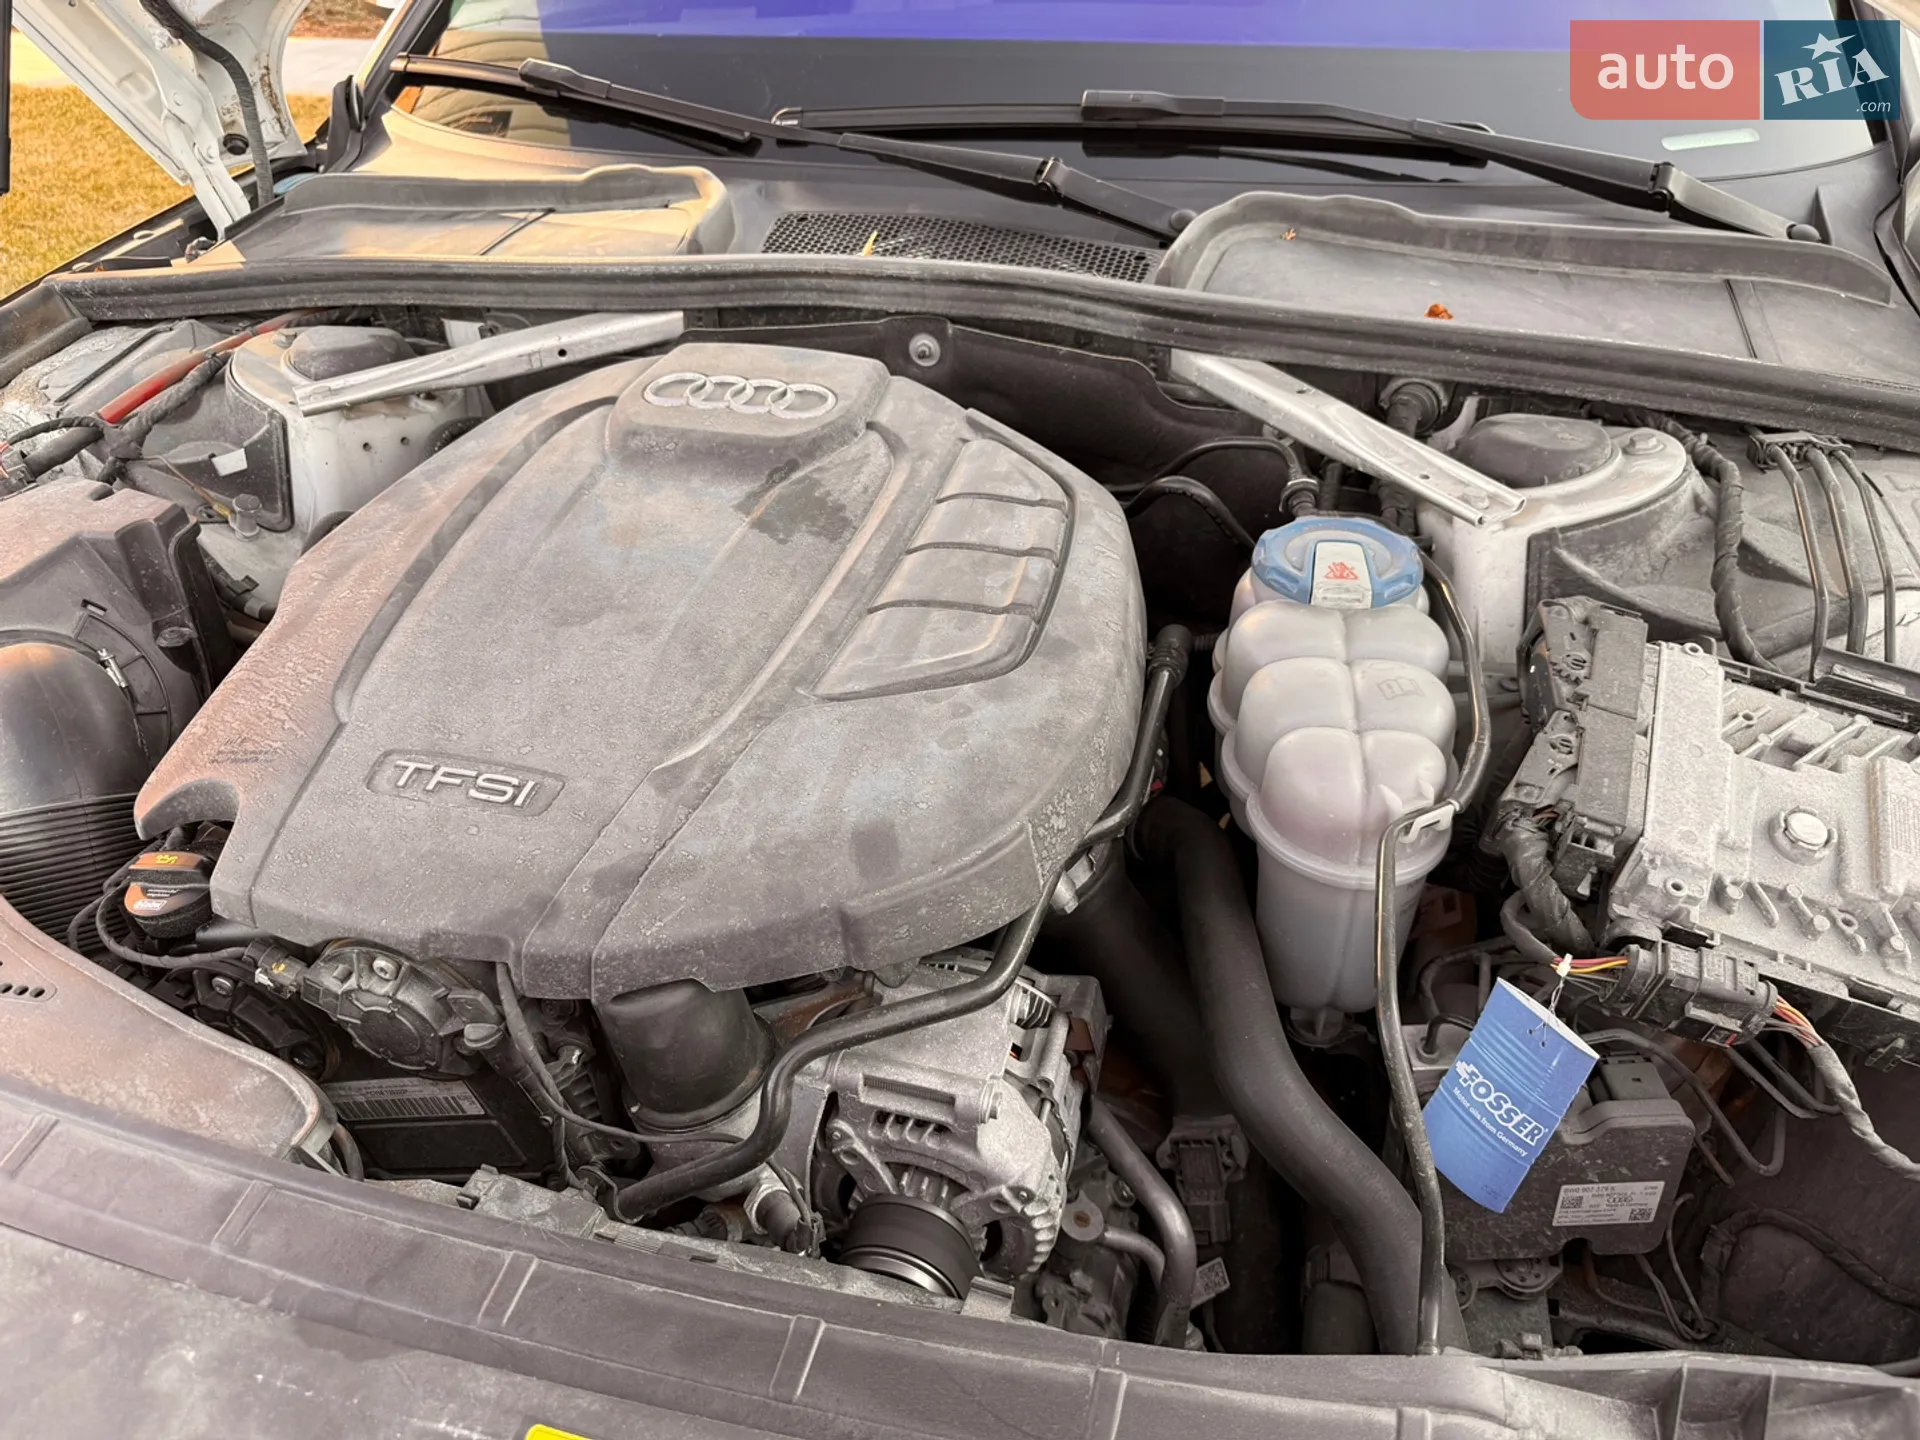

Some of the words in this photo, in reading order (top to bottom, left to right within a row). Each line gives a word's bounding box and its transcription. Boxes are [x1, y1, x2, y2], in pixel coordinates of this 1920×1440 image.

[395, 760, 536, 808] TFSI
[1453, 1086, 1471, 1109] Motor
[1469, 1106, 1483, 1121] oils
[1481, 1117, 1498, 1136] from
[1496, 1131, 1528, 1157] Germany
[1456, 1061, 1545, 1146] FOSSER
